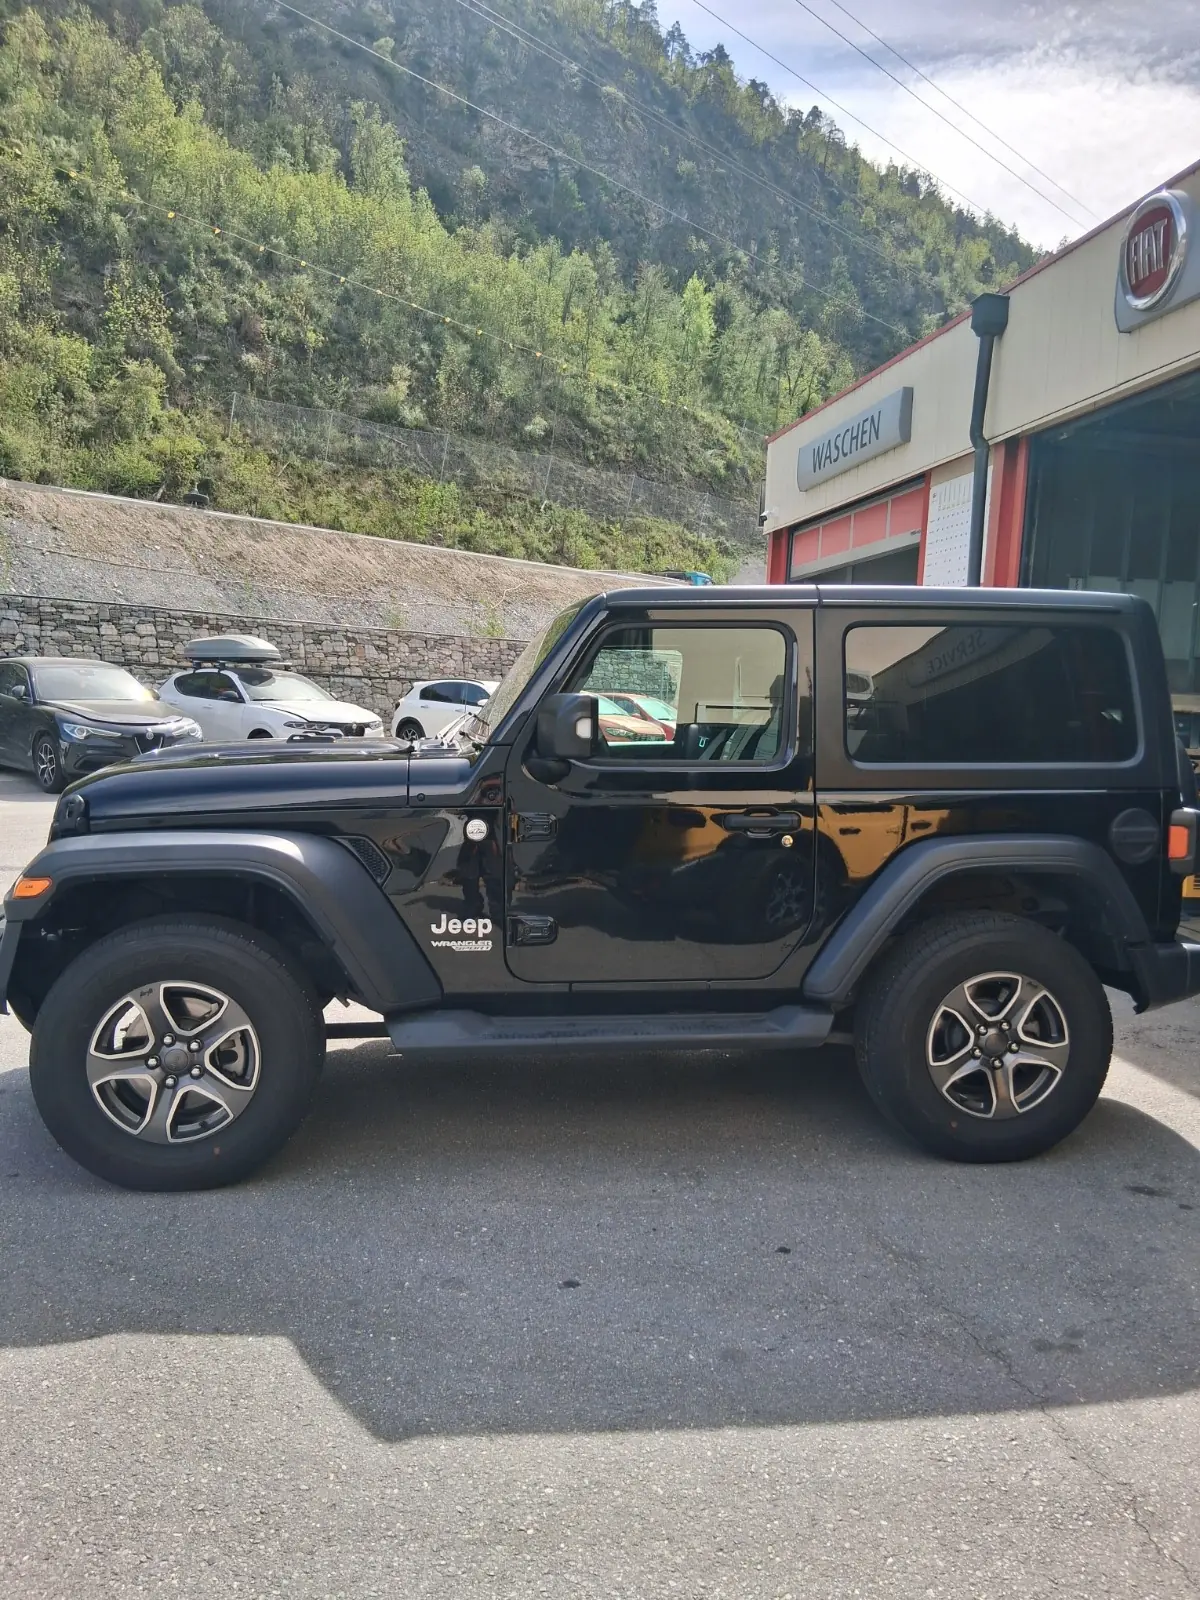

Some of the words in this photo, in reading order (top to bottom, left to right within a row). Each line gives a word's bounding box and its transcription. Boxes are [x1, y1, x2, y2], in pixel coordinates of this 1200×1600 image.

[1129, 218, 1168, 285] FIAT
[812, 410, 882, 473] WASCHEN
[430, 913, 493, 938] Jeep
